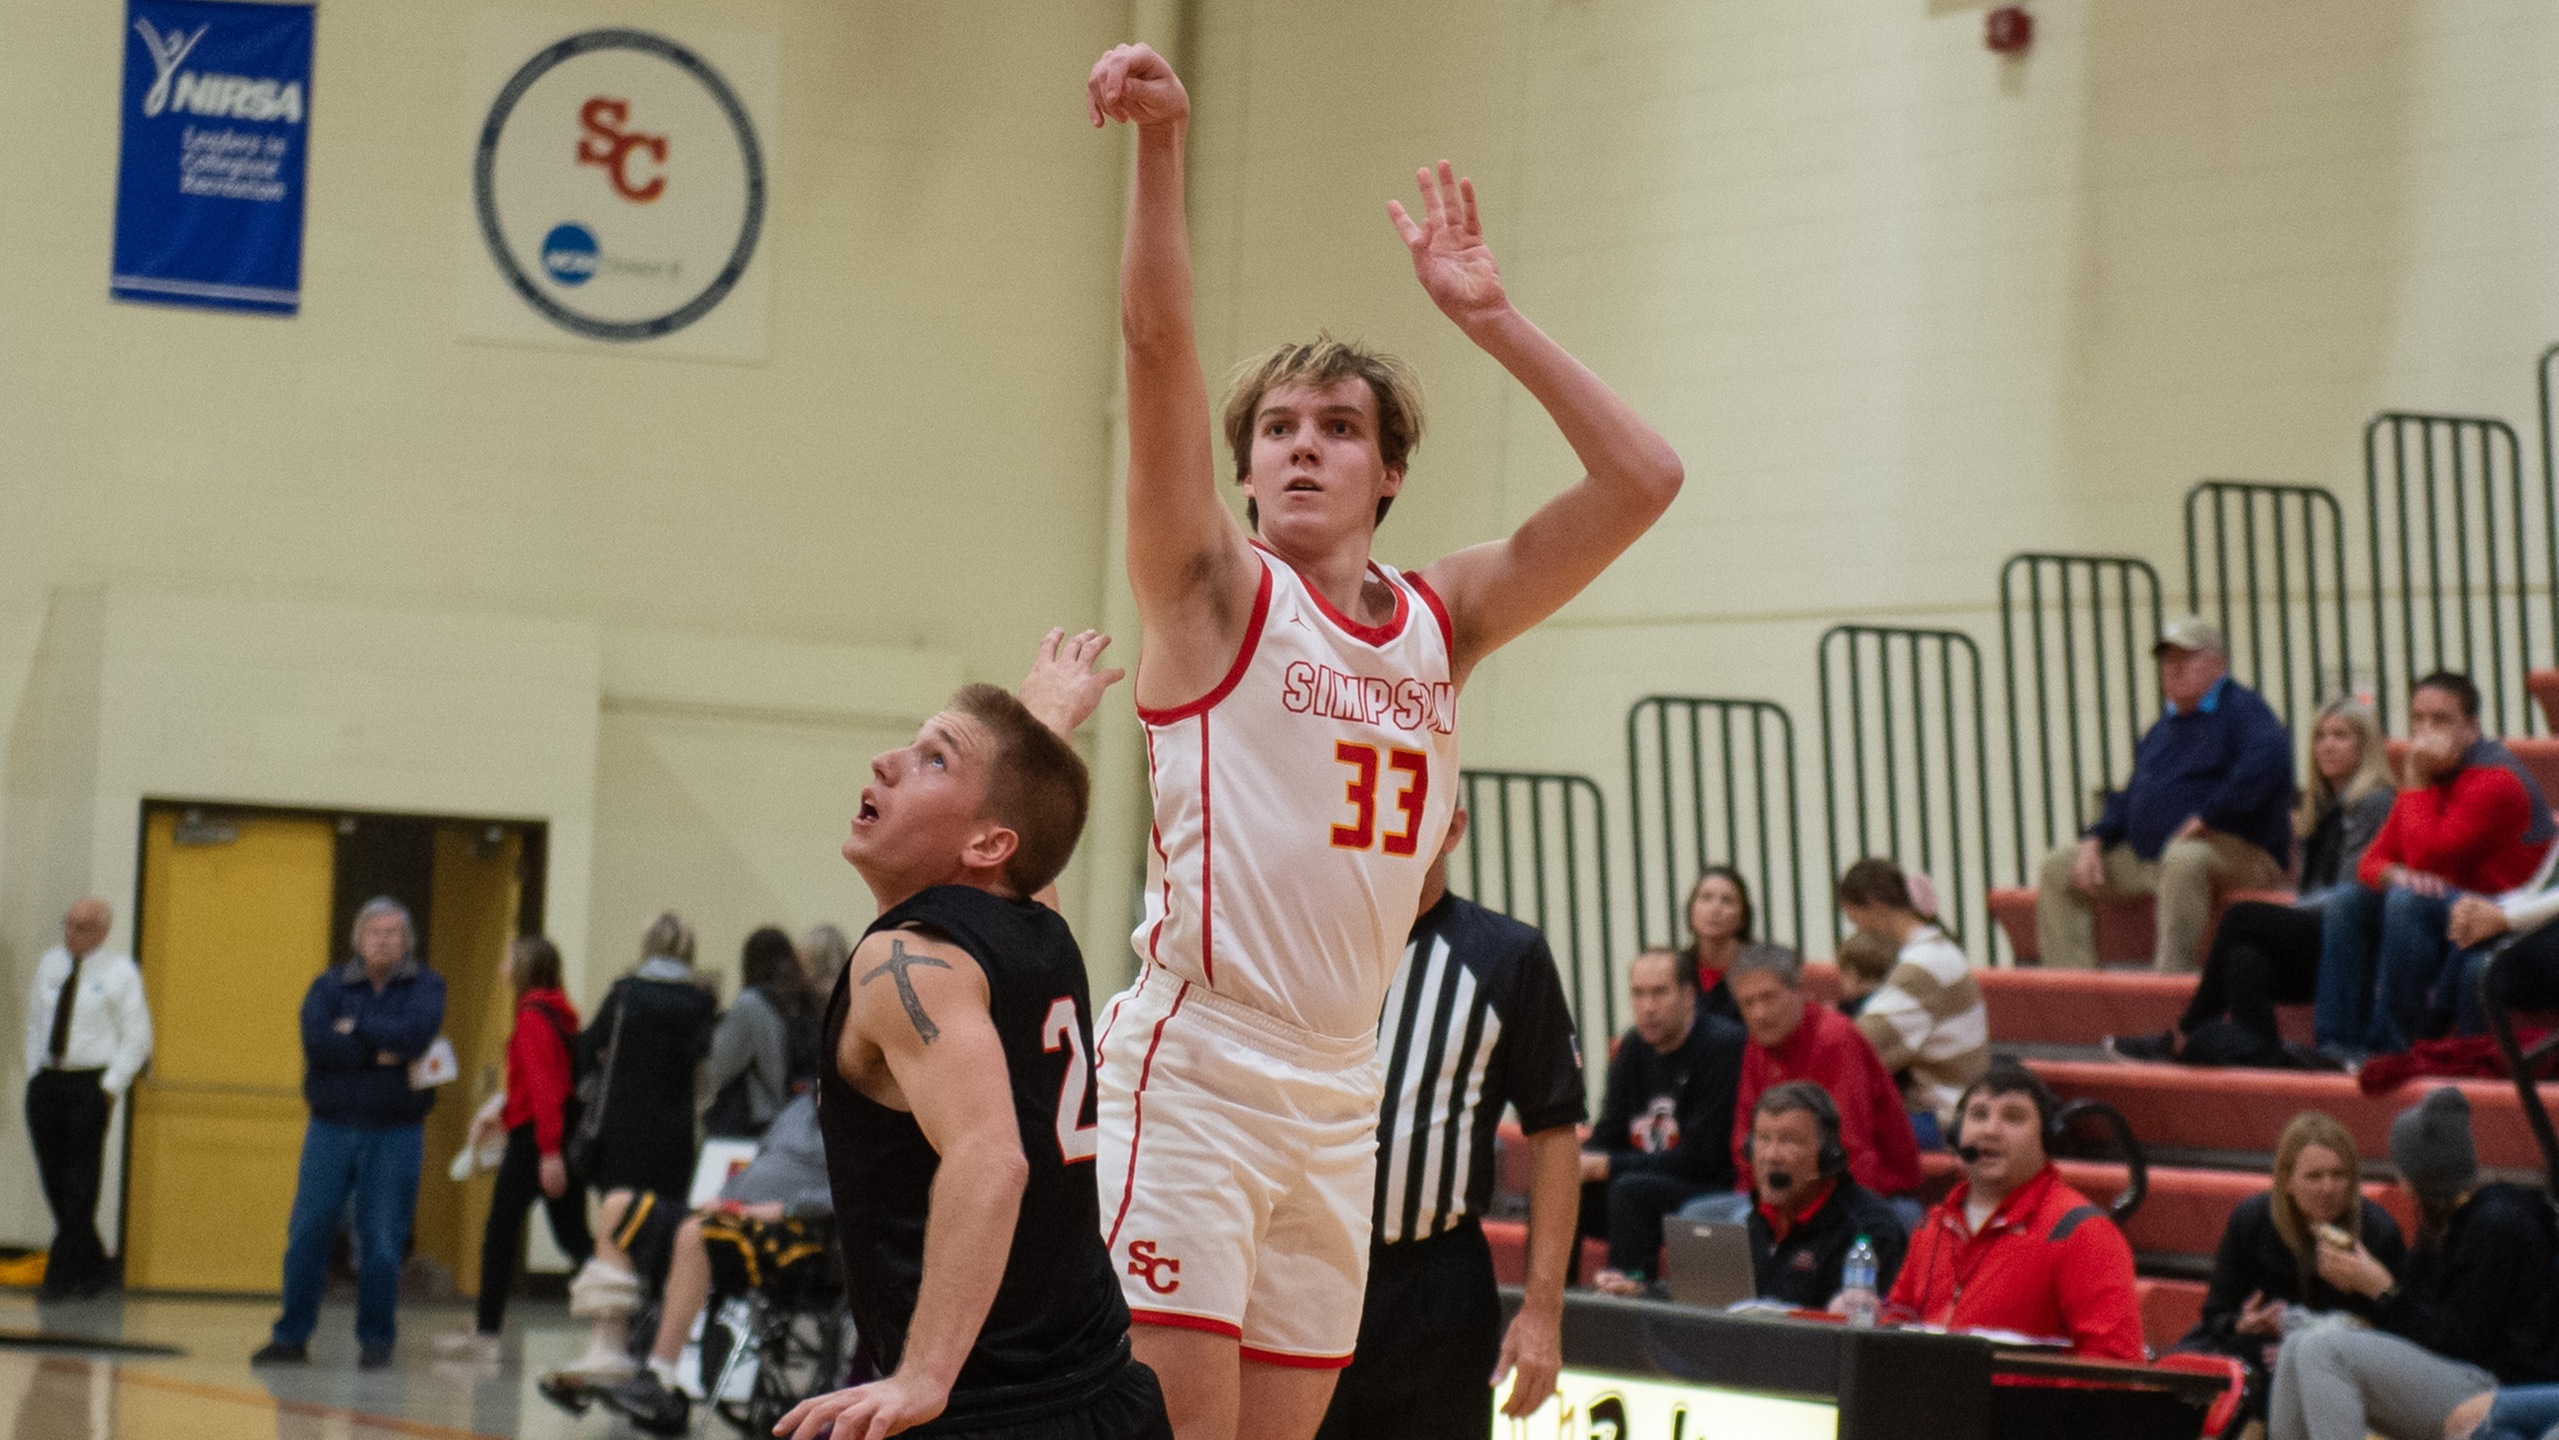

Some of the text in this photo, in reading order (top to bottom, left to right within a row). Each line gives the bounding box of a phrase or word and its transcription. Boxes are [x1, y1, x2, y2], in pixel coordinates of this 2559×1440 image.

[171, 70, 302, 123] NIRSA
[577, 97, 668, 204] SC
[1329, 739, 1429, 859] 33
[1128, 1240, 1180, 1294] SC
